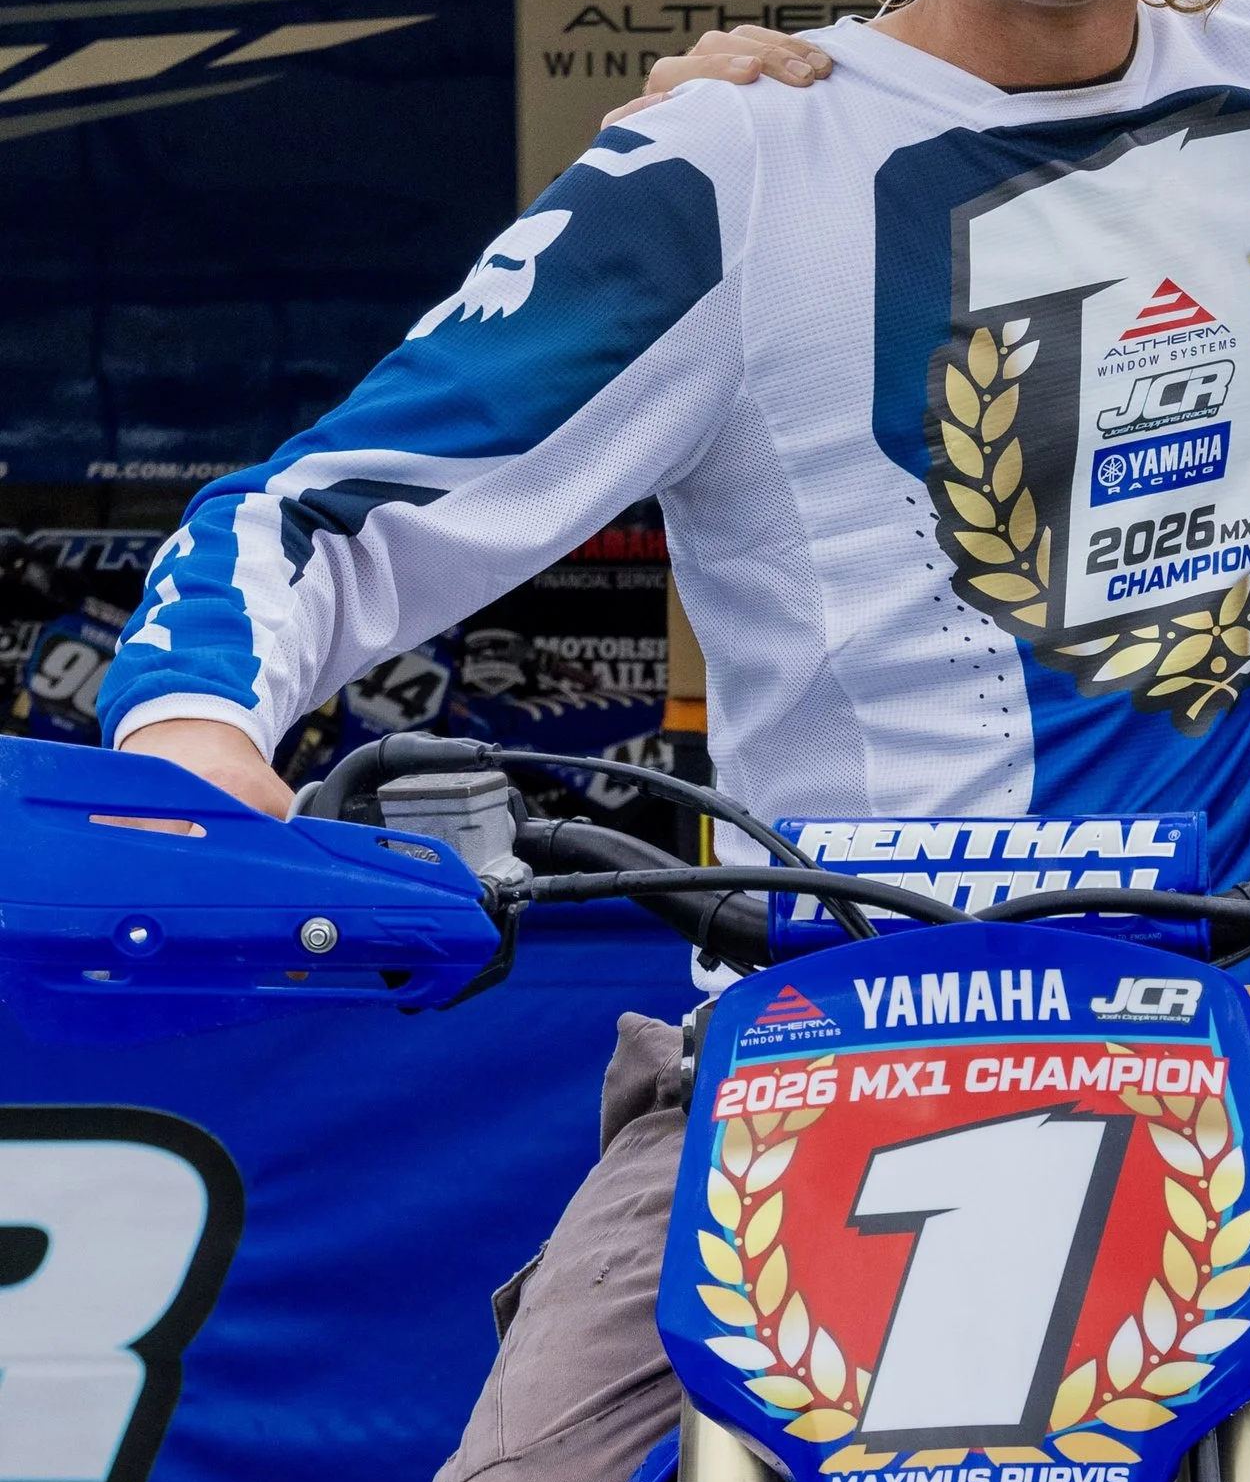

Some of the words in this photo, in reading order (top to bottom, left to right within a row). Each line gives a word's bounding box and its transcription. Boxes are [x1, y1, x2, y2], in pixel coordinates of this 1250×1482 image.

[1097, 354, 1160, 377] WINDOW
[1170, 337, 1237, 361] SYSTEMS
[1104, 324, 1231, 360] ALTHERM
[1097, 359, 1236, 431] JCR
[1104, 424, 1134, 438] Josh
[1135, 414, 1181, 433] Coppins
[1181, 406, 1217, 423] Racing
[1128, 433, 1222, 479] YAMAHA
[1107, 465, 1215, 495] RACING
[1086, 504, 1216, 575] 2026
[797, 820, 1177, 862] RENTHAL
[853, 969, 1071, 1028] YAMAHA
[1090, 977, 1203, 1016] JCR
[740, 1034, 784, 1047] WINDOW
[790, 1027, 842, 1041] SYSTEMS
[744, 1018, 837, 1037] ALTHERM
[717, 1068, 837, 1117] 2026
[850, 1060, 952, 1103] MX1
[964, 1055, 1226, 1096] CHAMPION
[852, 1112, 1110, 1434] 1
